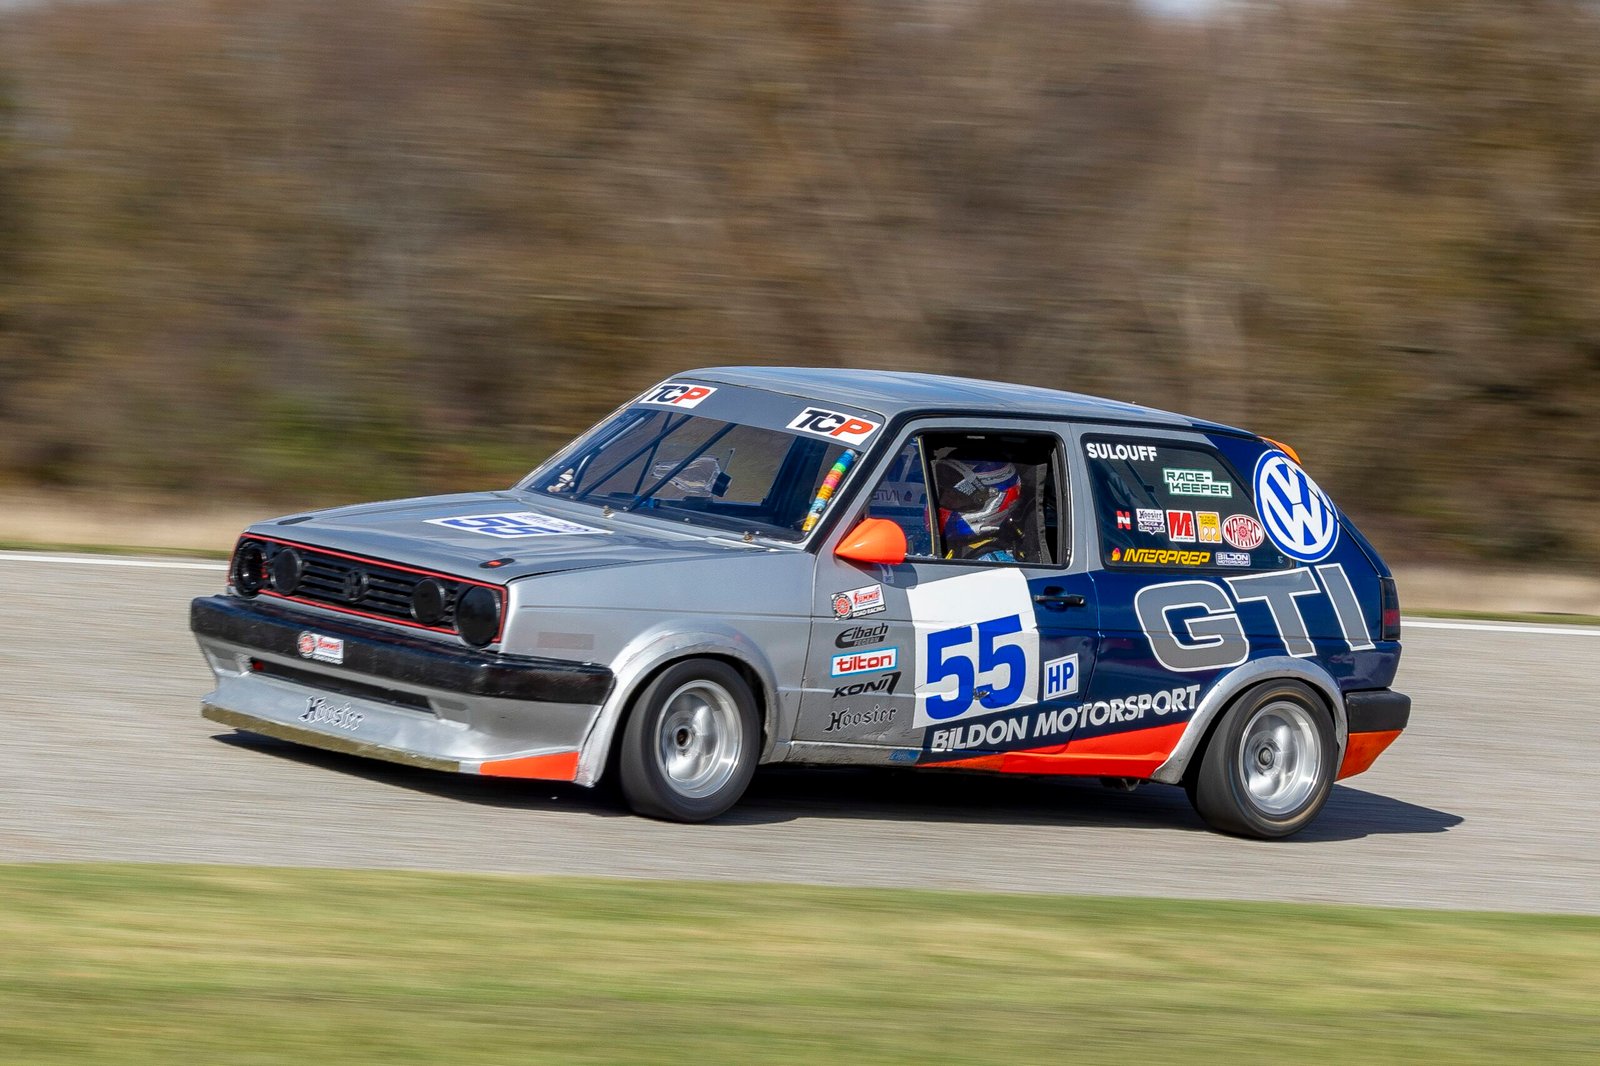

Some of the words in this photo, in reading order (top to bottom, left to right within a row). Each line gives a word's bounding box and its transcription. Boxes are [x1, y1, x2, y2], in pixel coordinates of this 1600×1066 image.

[647, 385, 711, 404] TCP
[796, 409, 873, 437] TCP
[1086, 443, 1158, 462] SULOUFF
[1166, 471, 1211, 483] RACE-
[1171, 483, 1230, 495] KEEPER
[441, 516, 562, 535] 55
[1116, 510, 1131, 530] N
[1123, 548, 1211, 565] INTERPREP
[1134, 563, 1376, 672] GTI
[835, 622, 889, 648] Eibach
[836, 655, 892, 673] tilton
[925, 613, 1026, 720] 55
[832, 677, 889, 698] KONI
[1048, 661, 1074, 694] HP
[298, 695, 365, 731] Hoosier
[824, 703, 897, 732] Hoosier
[931, 715, 1029, 753] BILDON
[1032, 684, 1201, 737] MOTORSPORT
